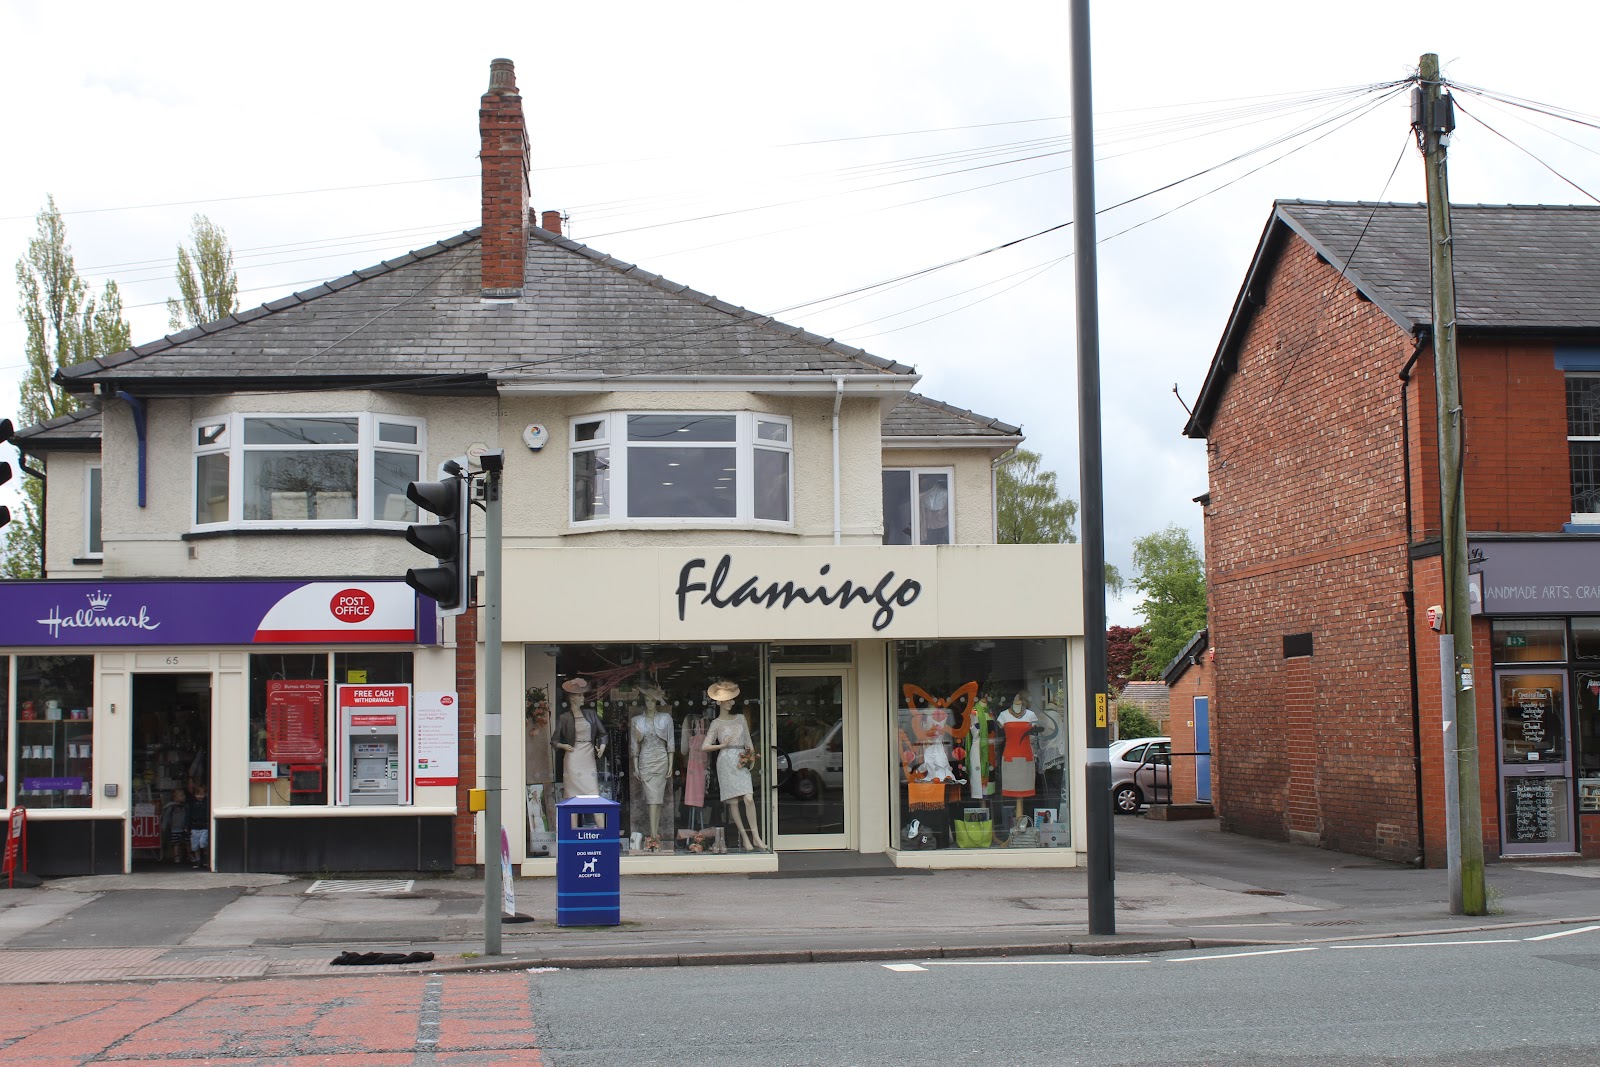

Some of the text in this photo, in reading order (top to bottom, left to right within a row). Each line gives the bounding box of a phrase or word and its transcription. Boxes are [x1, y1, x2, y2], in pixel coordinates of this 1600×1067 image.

[676, 554, 921, 631] Flamingo
[340, 597, 365, 606] POST
[335, 606, 369, 615] OFFICE
[36, 605, 161, 638] Hallmark
[166, 656, 179, 665] 65
